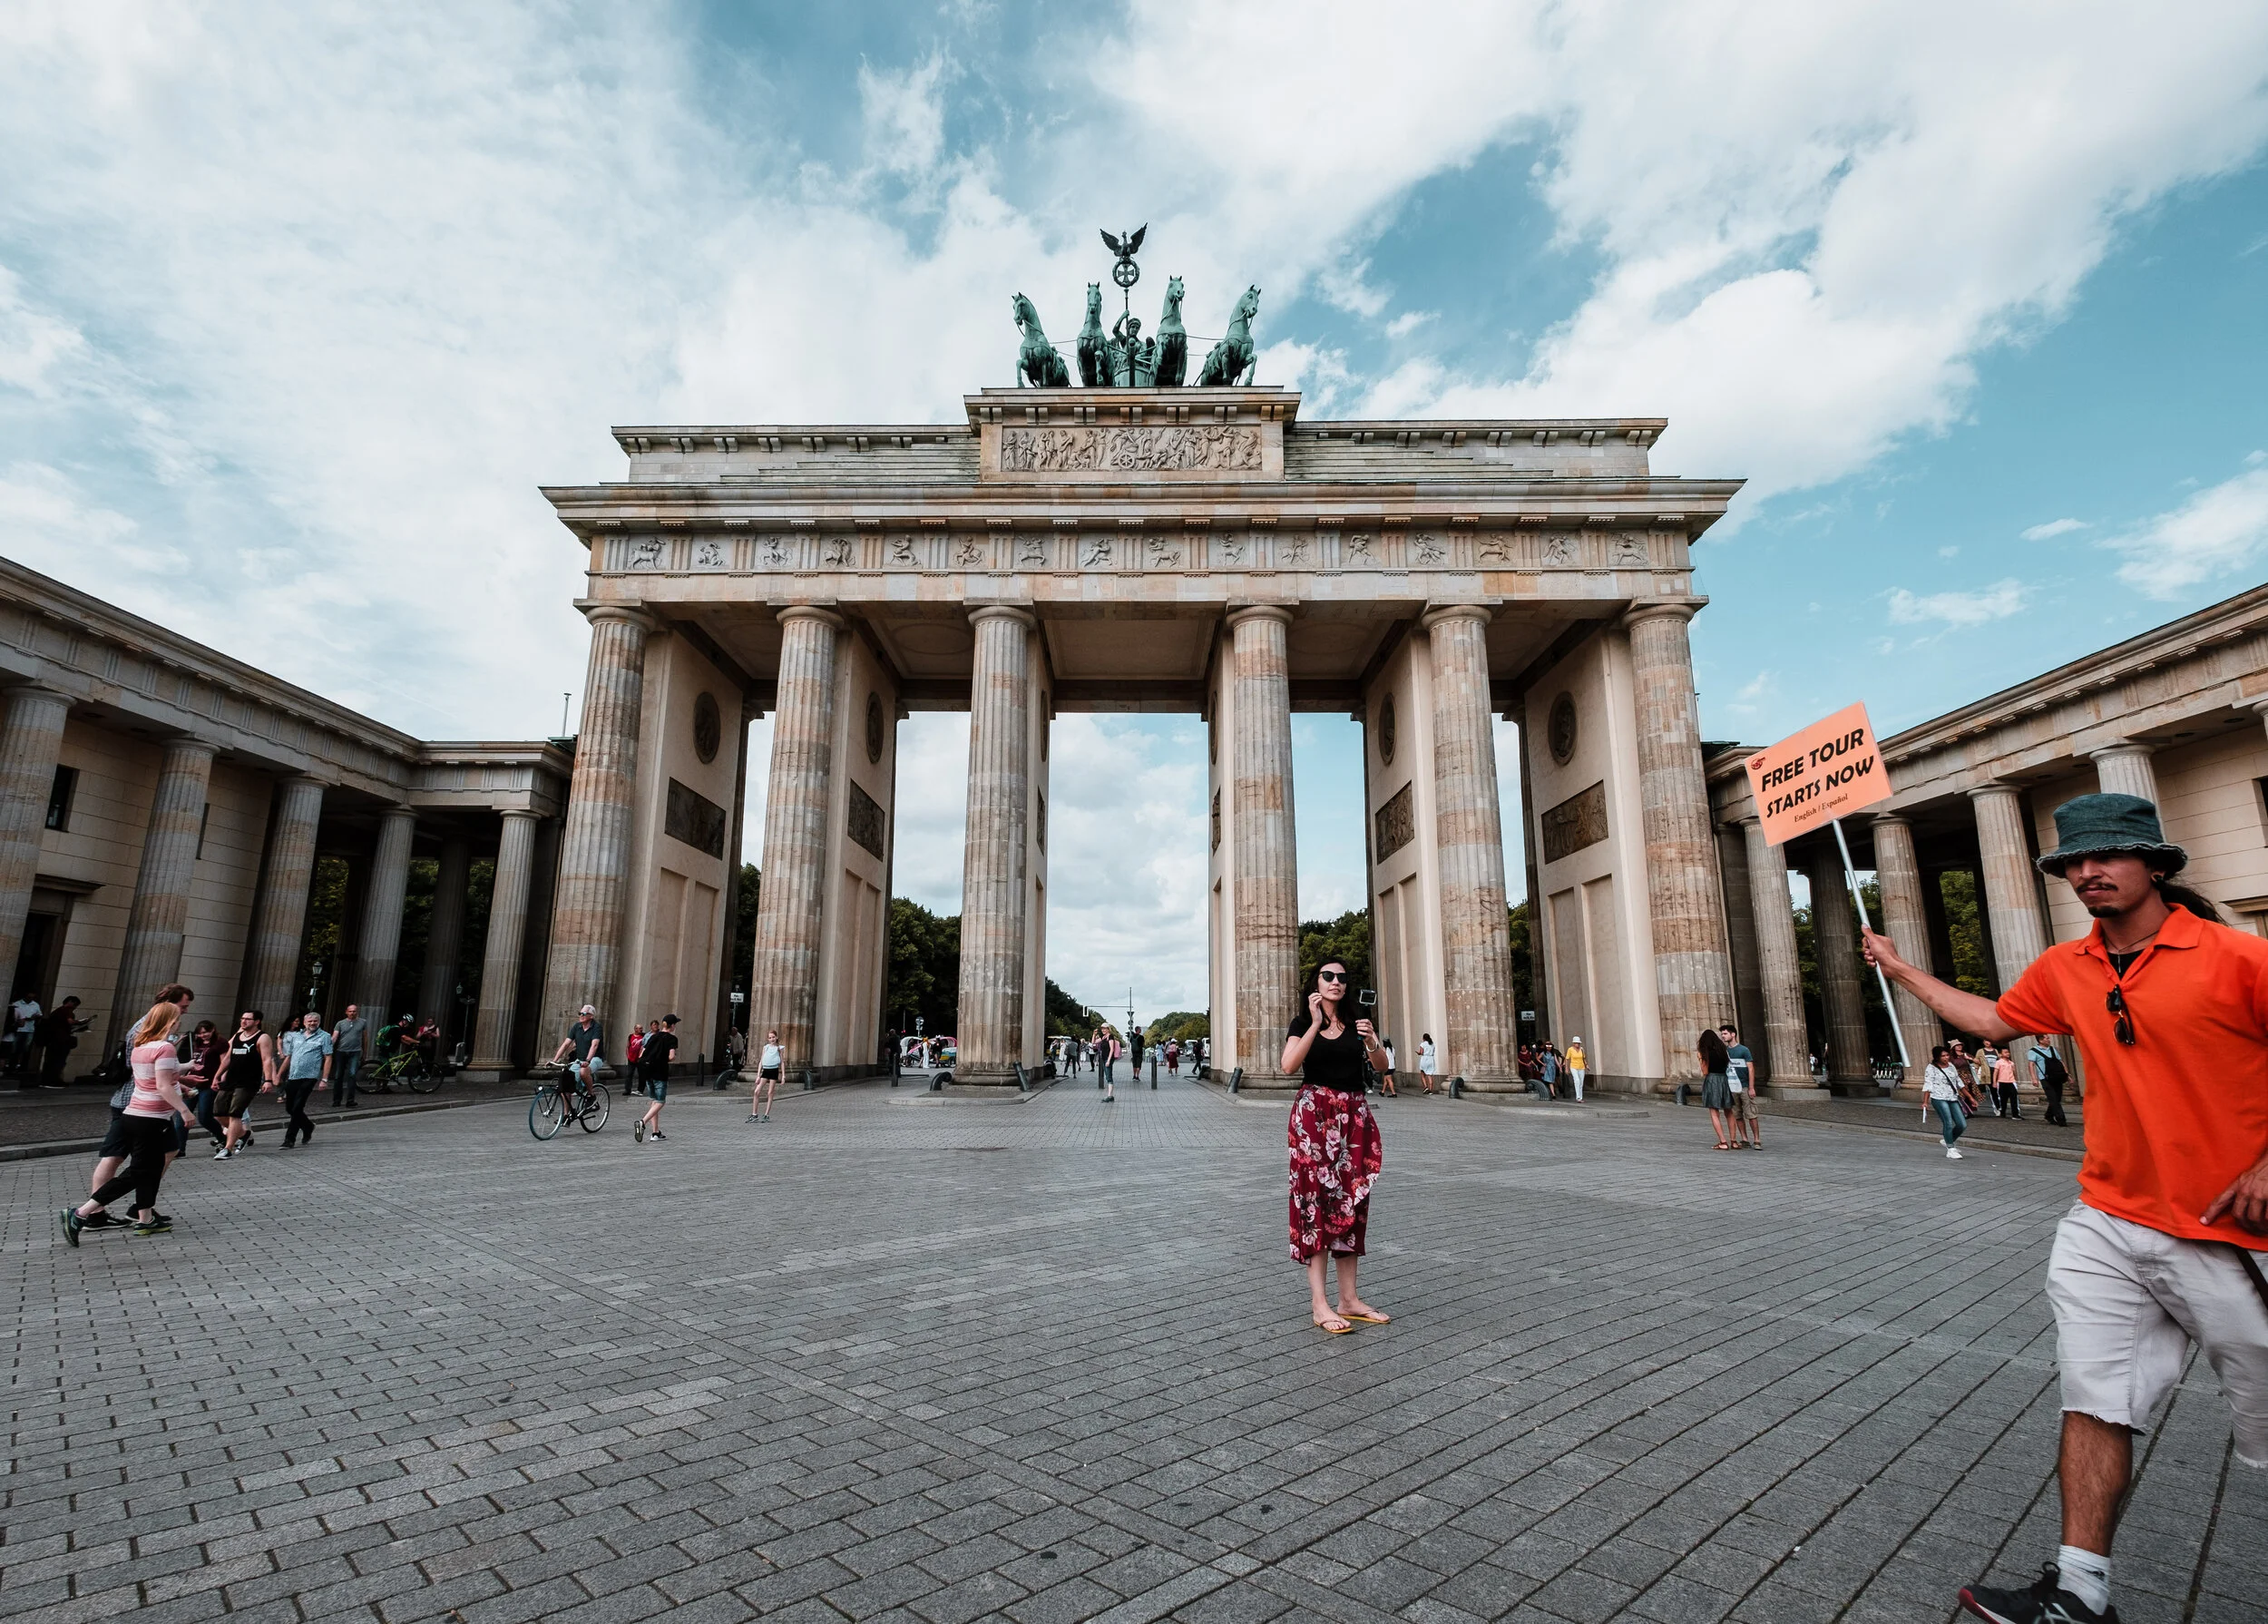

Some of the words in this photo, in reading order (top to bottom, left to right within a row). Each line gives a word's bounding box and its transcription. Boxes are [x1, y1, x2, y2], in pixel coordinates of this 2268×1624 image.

[1762, 756, 1804, 792] FREE
[1809, 729, 1864, 768] TOUR
[1766, 778, 1821, 818] STARTS
[1825, 755, 1874, 791] NOW
[1794, 807, 1817, 823] English
[1822, 793, 1848, 809] Español
